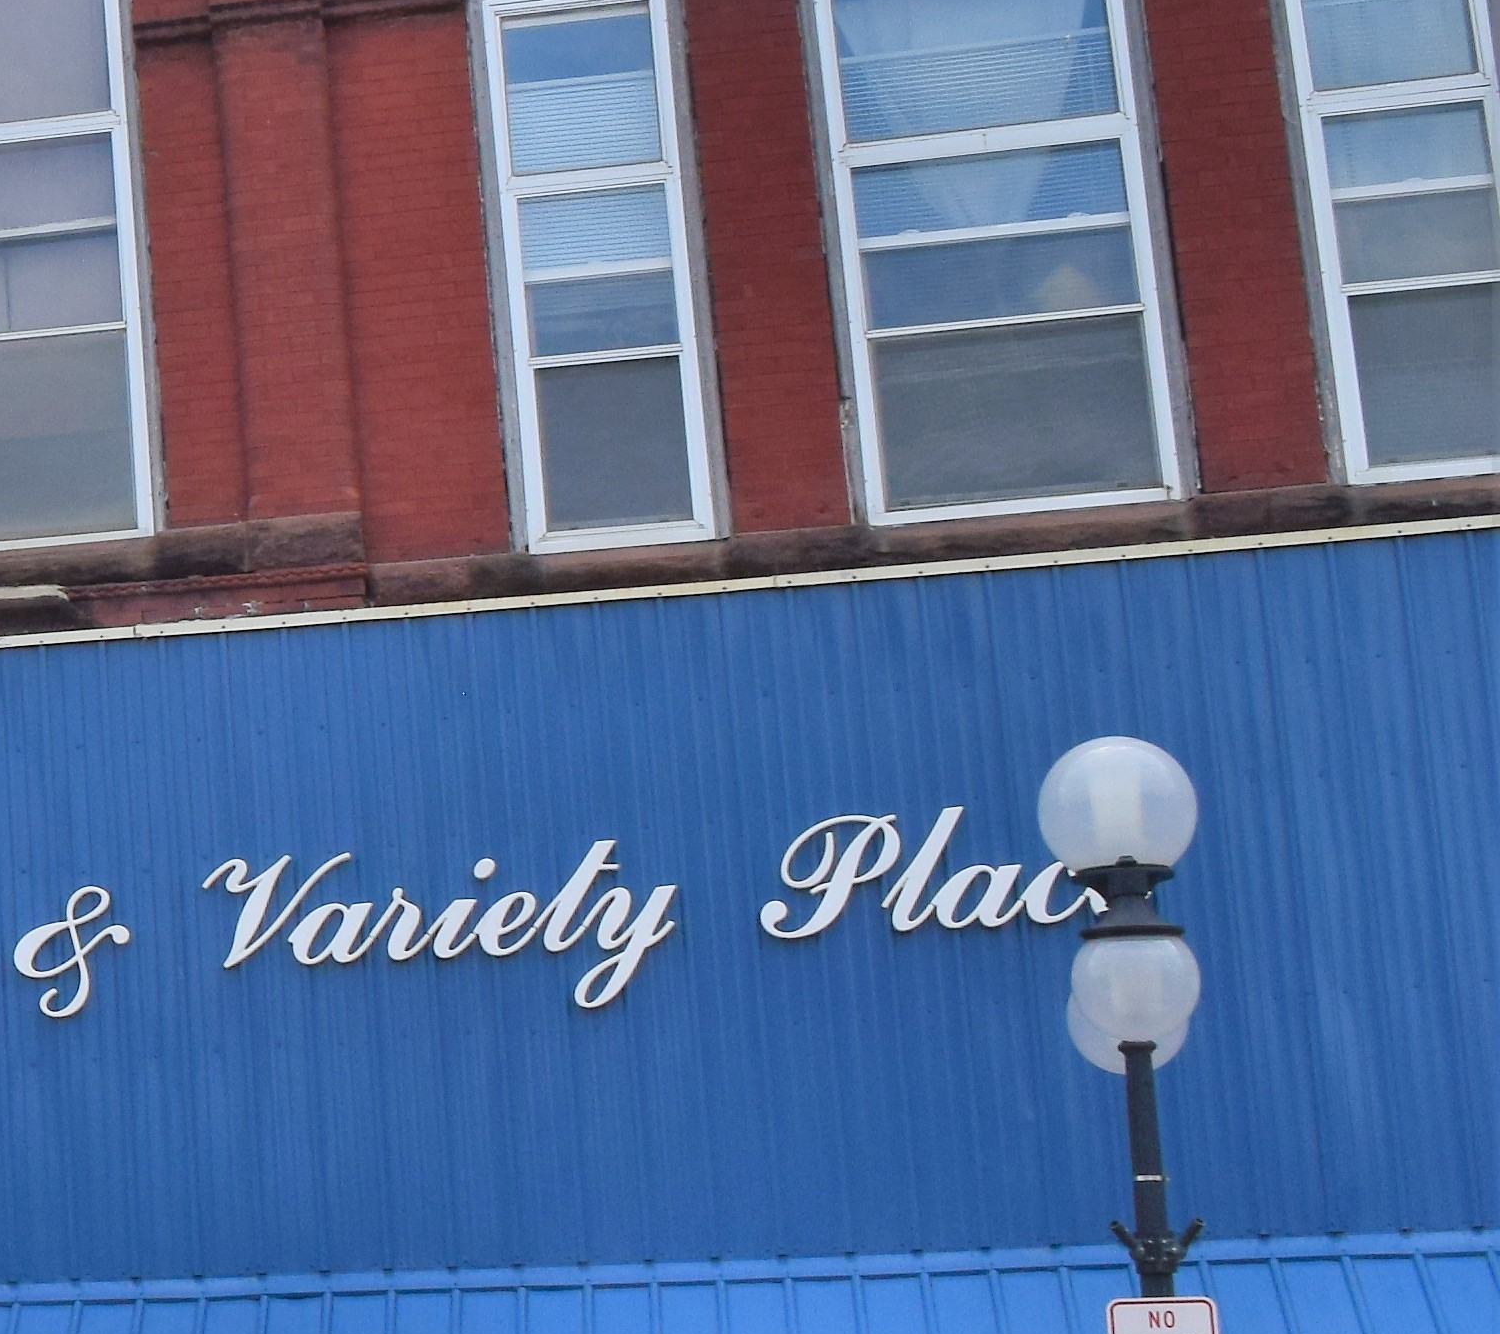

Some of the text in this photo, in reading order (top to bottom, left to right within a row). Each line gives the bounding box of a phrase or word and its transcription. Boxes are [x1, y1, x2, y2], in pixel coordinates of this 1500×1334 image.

[13, 884, 131, 1019] &
[200, 837, 678, 1010] Variety
[759, 805, 1110, 939] Plac
[1148, 1309, 1175, 1329] NO
